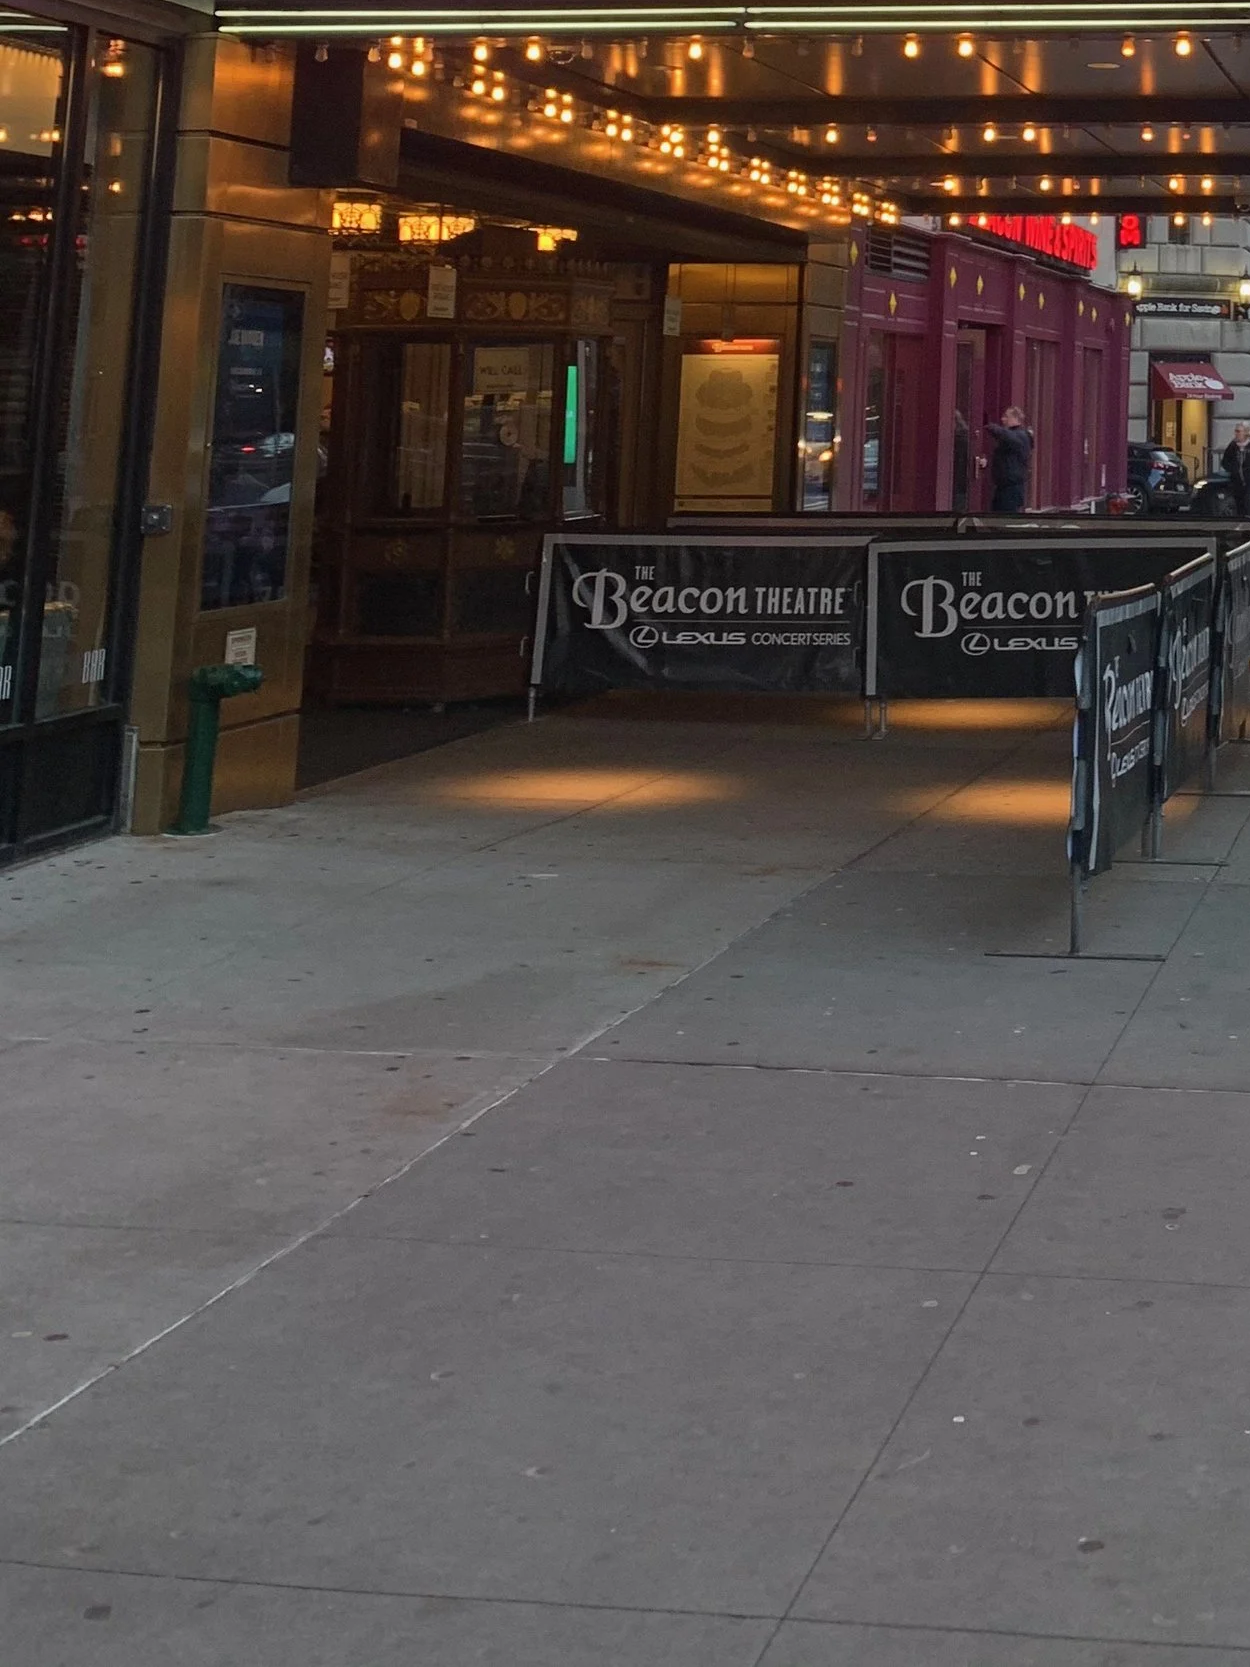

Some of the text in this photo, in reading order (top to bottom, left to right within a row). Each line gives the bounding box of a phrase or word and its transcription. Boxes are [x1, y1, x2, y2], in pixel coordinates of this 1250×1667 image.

[634, 565, 655, 580] THE
[961, 571, 983, 587] THE
[572, 568, 845, 630] Beacon THEATRE
[901, 575, 1079, 638] Beacon
[662, 631, 747, 645] LEXUS
[993, 636, 1079, 651] LEXUS
[82, 648, 106, 684] BAR
